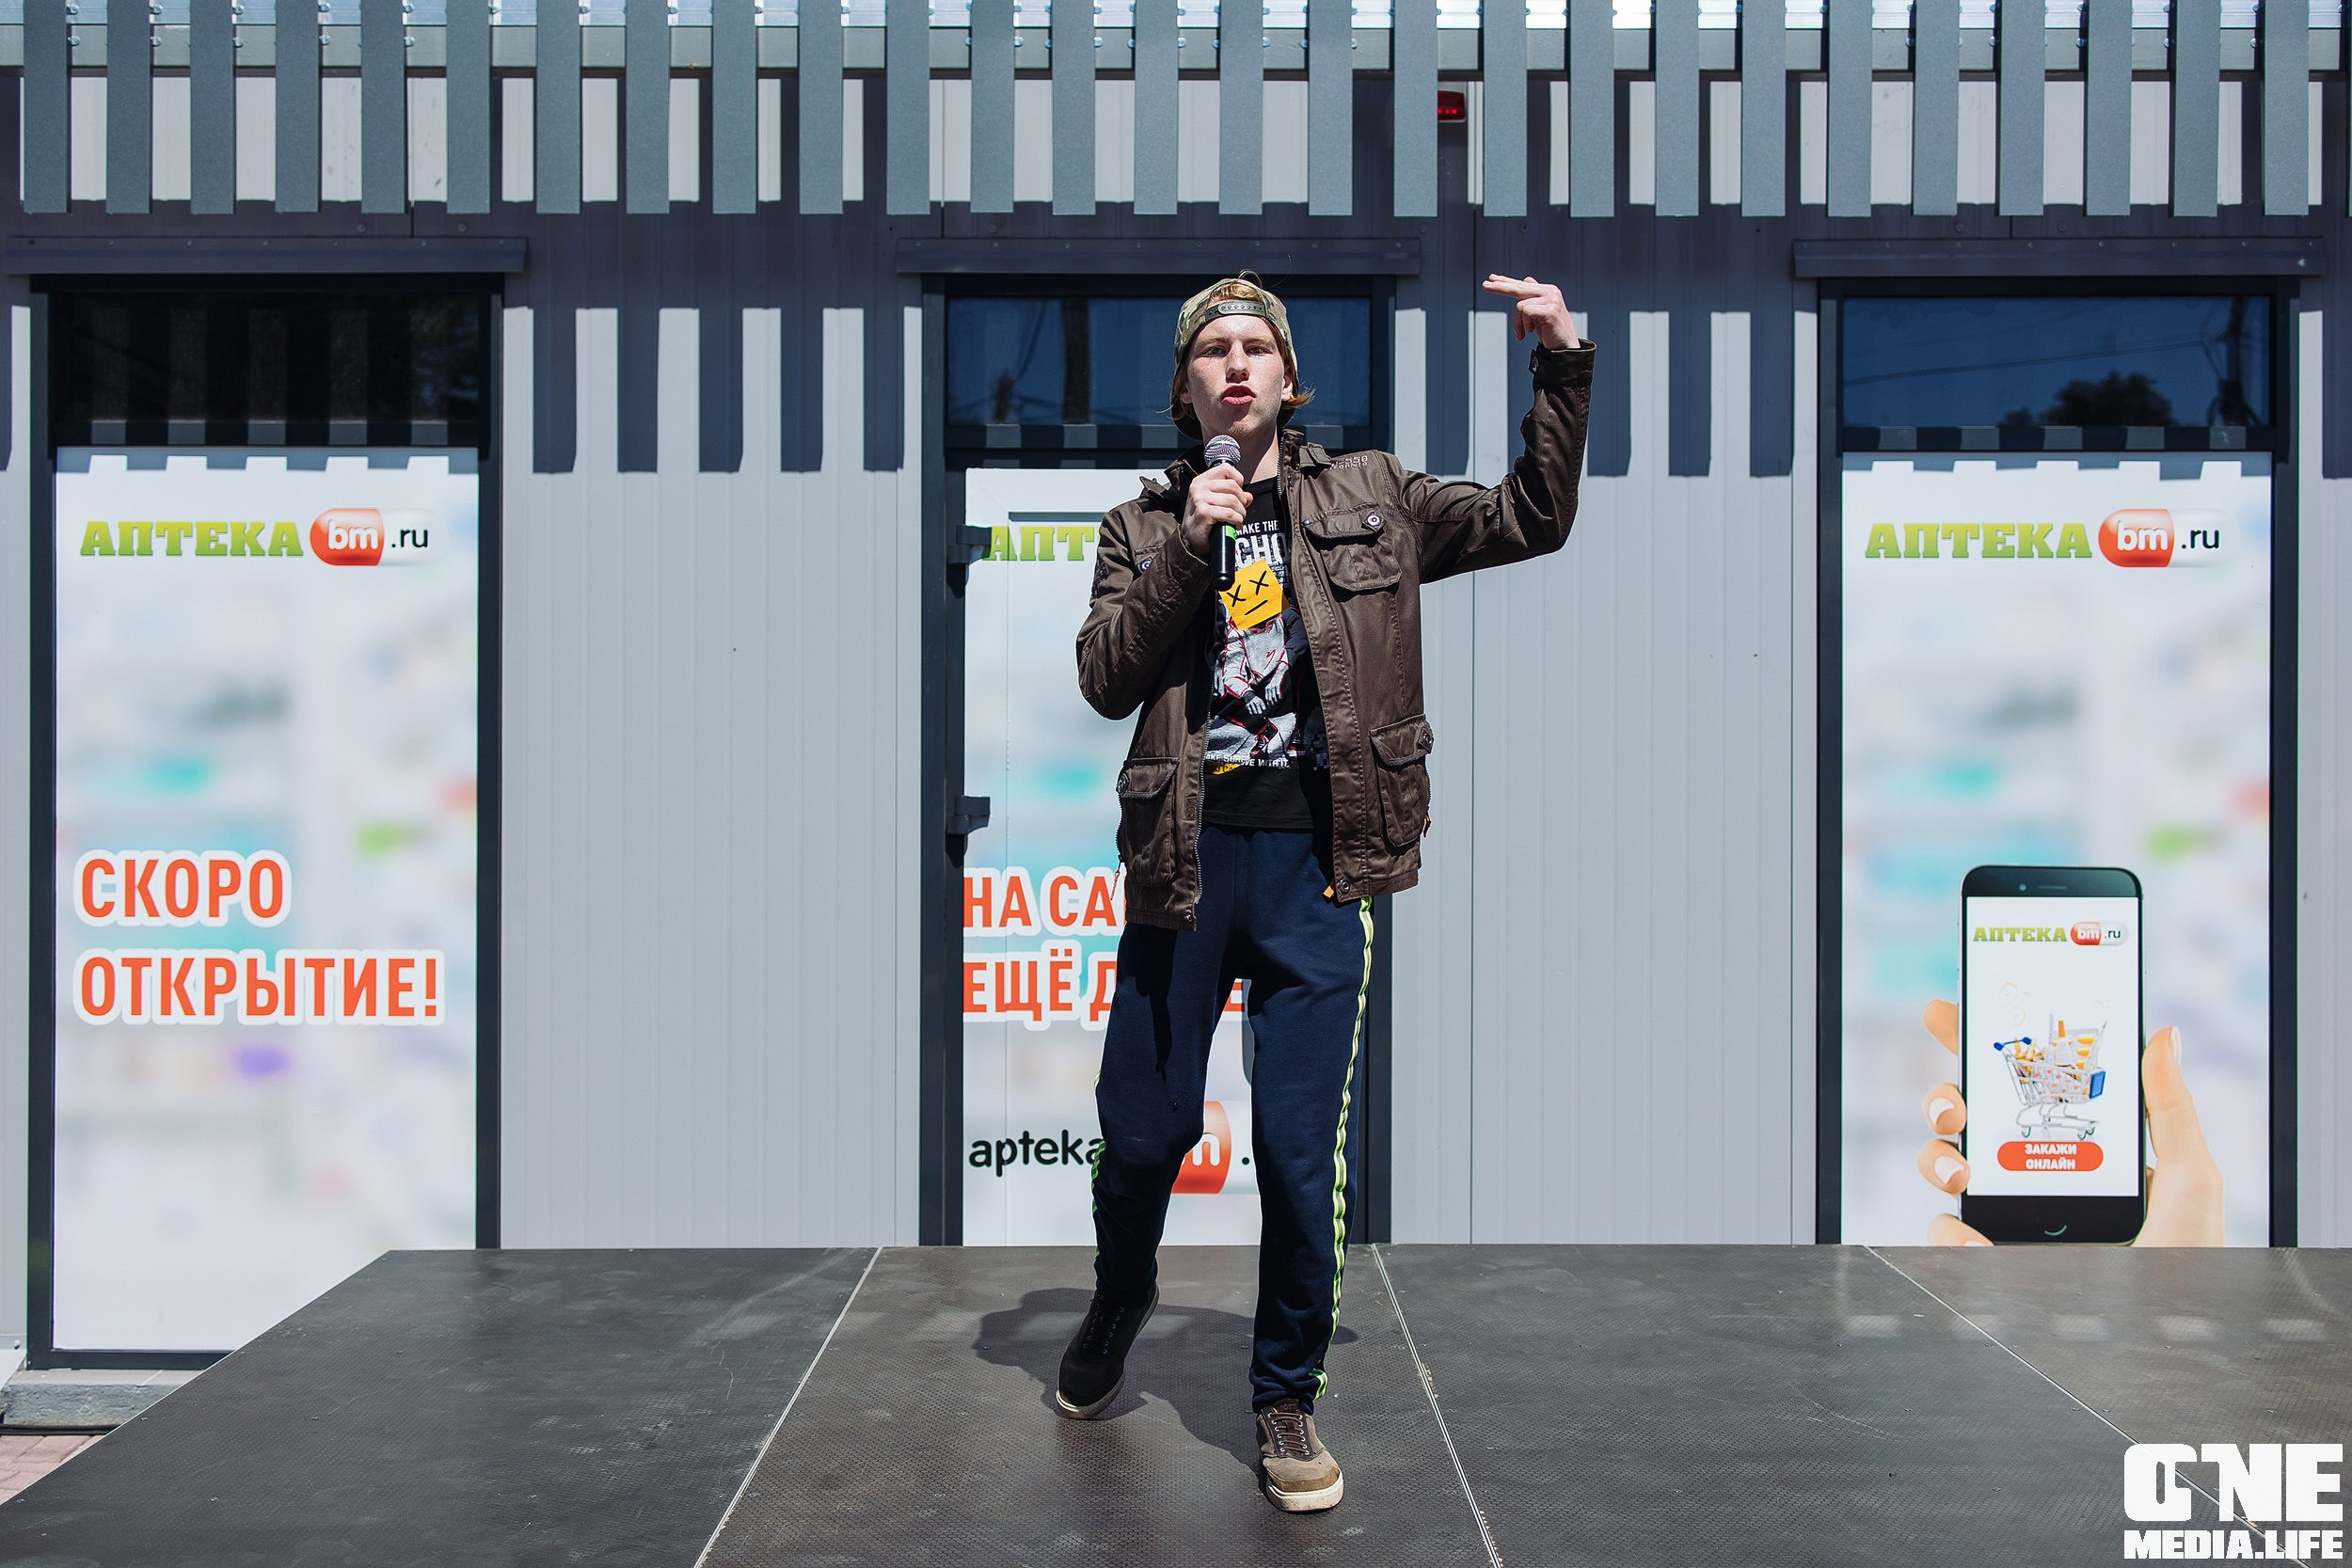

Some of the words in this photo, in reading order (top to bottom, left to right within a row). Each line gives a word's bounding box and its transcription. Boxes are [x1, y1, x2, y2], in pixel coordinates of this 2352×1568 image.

[80, 521, 304, 557] АПТЕКА
[981, 526, 1101, 562] АПТ
[1865, 523, 2093, 559] АПТЕКА
[81, 858, 284, 918] СКОРО
[962, 876, 1032, 927] НА
[1049, 876, 1127, 927] СА
[1973, 927, 2068, 942] АПТЕКА
[81, 957, 437, 1018] ОТКРЫТИЕ!
[962, 948, 1073, 1022] ЕЩЁ
[2024, 1143, 2077, 1156] ЗАКАЖИ
[2025, 1158, 2076, 1171] ОНЛАЙН
